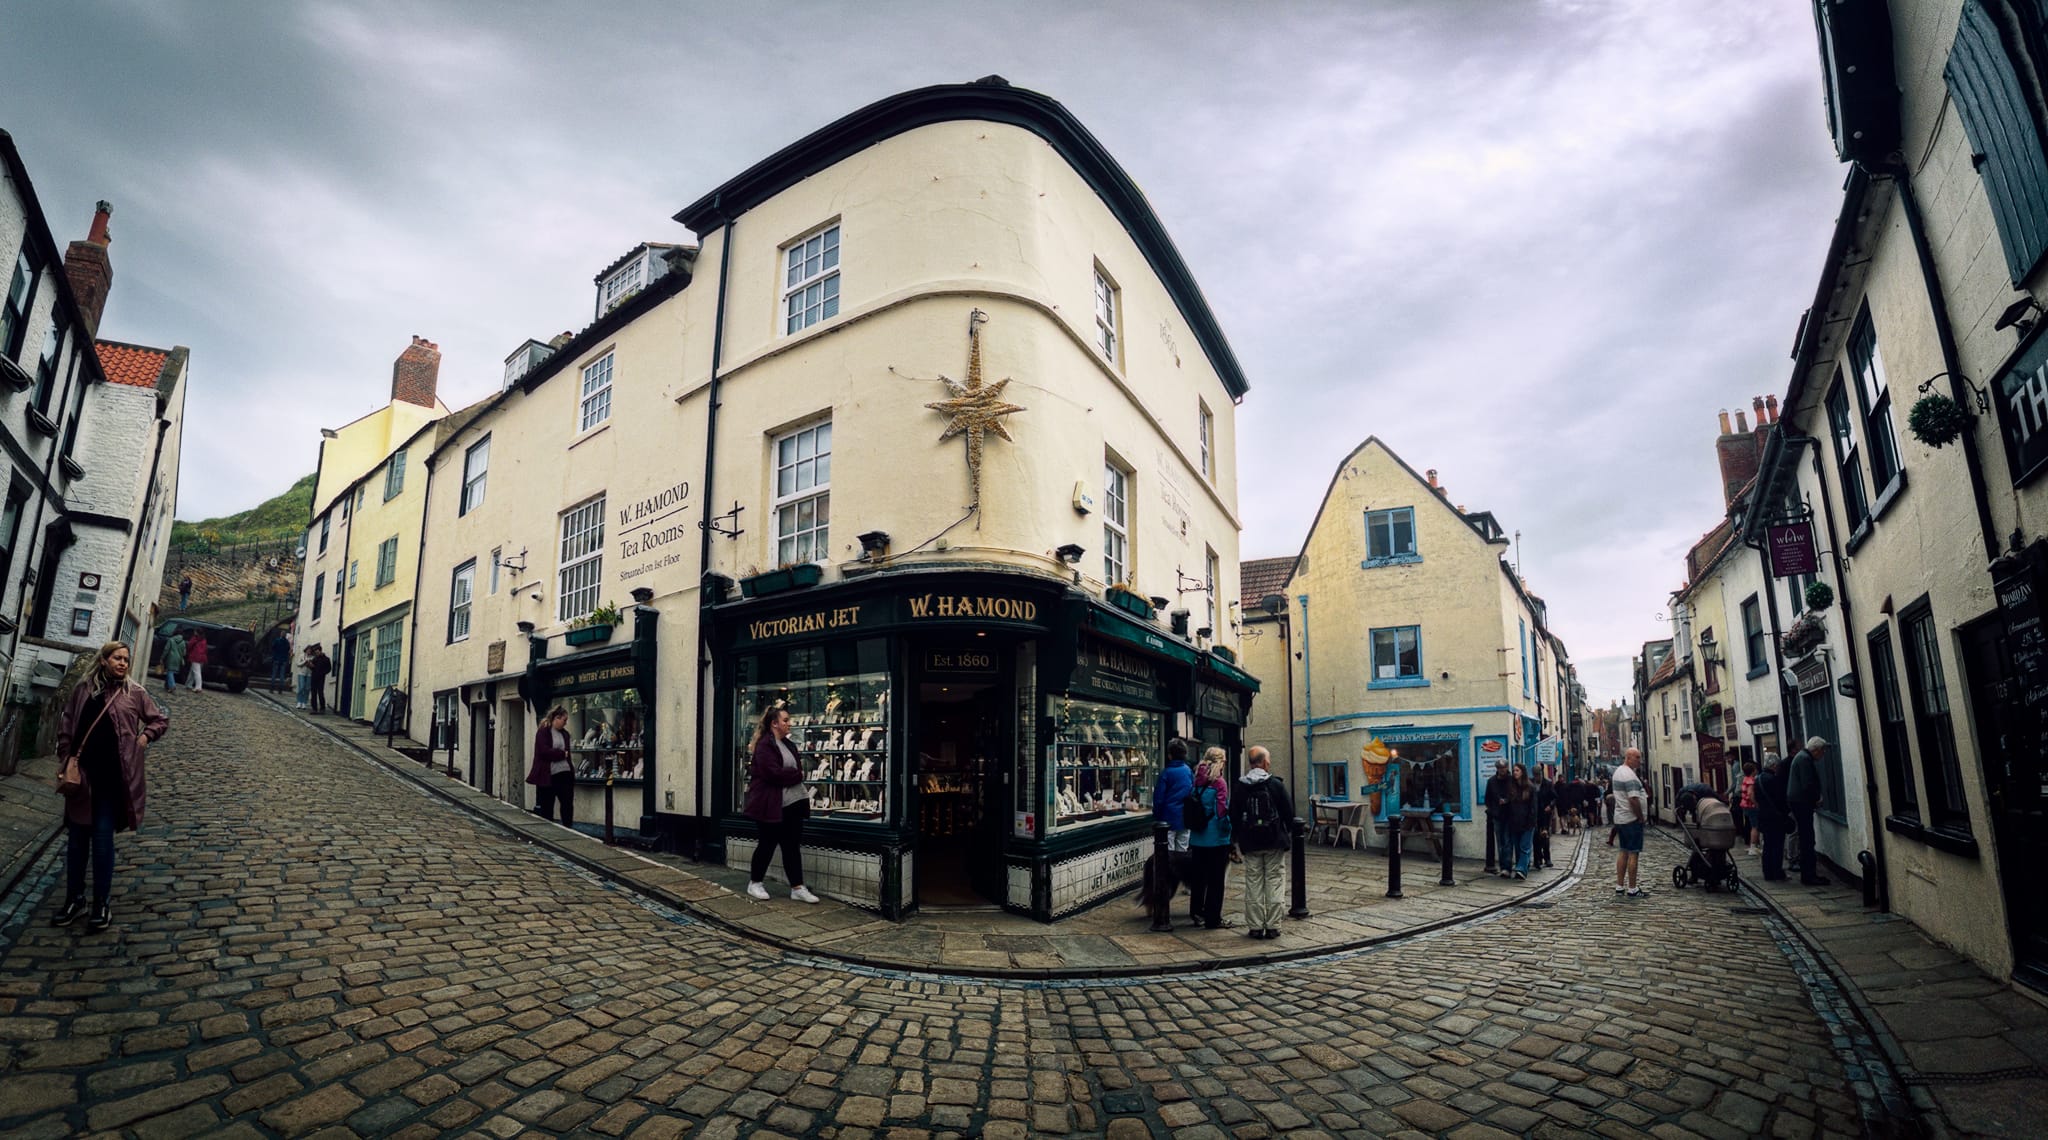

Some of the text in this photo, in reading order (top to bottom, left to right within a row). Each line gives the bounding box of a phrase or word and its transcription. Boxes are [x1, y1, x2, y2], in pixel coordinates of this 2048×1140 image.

[2010, 358, 2048, 444] TH
[620, 481, 689, 526] W. HAMOND
[620, 524, 684, 560] Tea Rooms
[620, 554, 681, 582] Situated on 1st Floor
[909, 593, 1037, 620] W. HAMOND
[749, 605, 860, 640] VICTORIAN JET
[933, 651, 990, 667] Est. 1860
[1110, 649, 1150, 679] HAMOND
[1091, 676, 1101, 688] THE
[1102, 848, 1140, 871] J. STORR
[1091, 875, 1103, 890] JET
